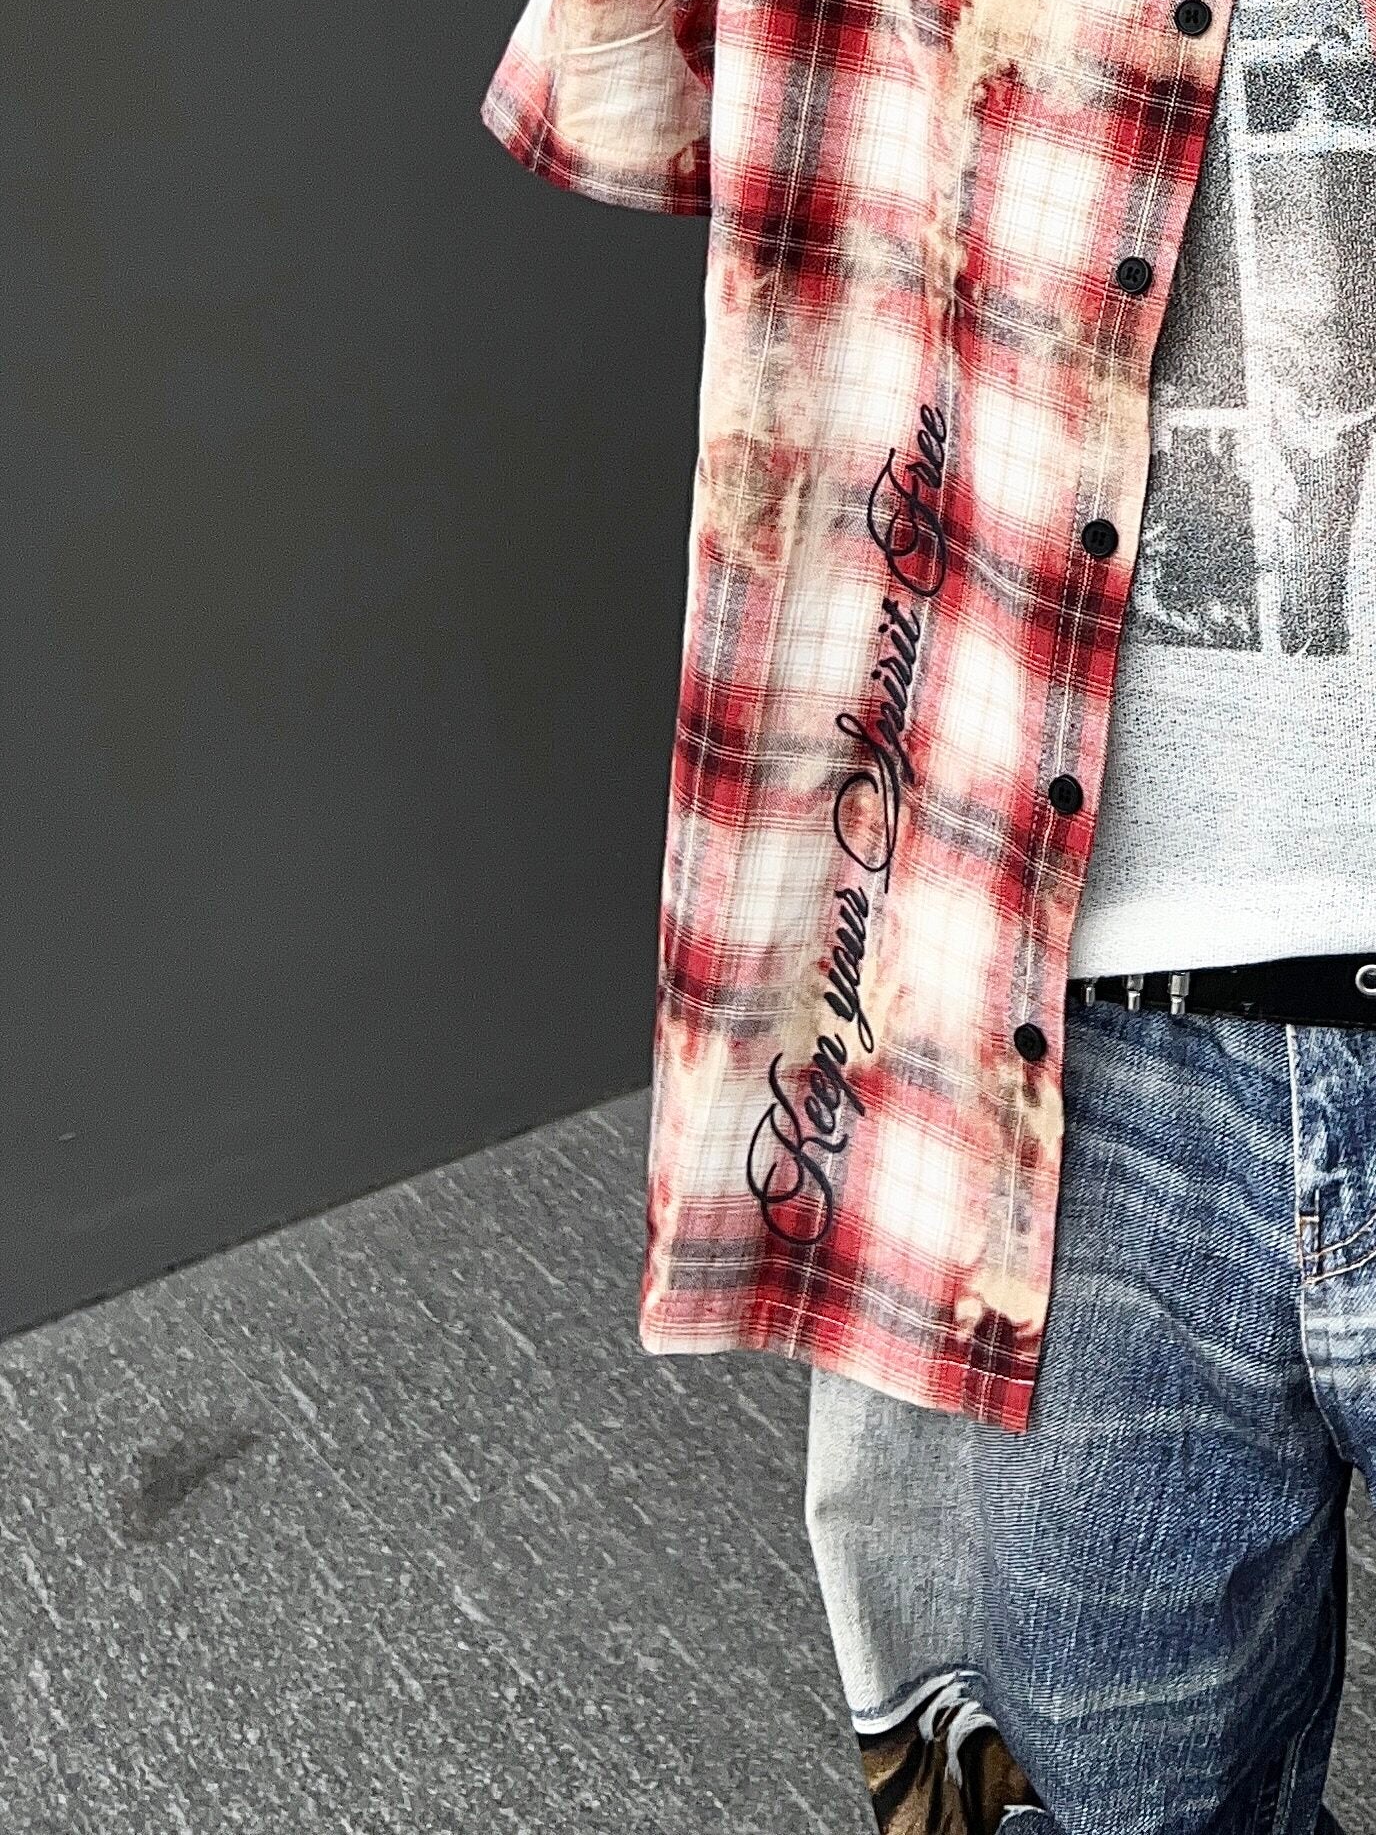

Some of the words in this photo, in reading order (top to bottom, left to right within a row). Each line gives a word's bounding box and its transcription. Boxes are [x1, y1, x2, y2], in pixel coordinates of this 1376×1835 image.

[866, 403, 948, 597] Free
[833, 598, 920, 894] Spirit
[823, 887, 874, 1054] your
[747, 1032, 865, 1246] Keep
